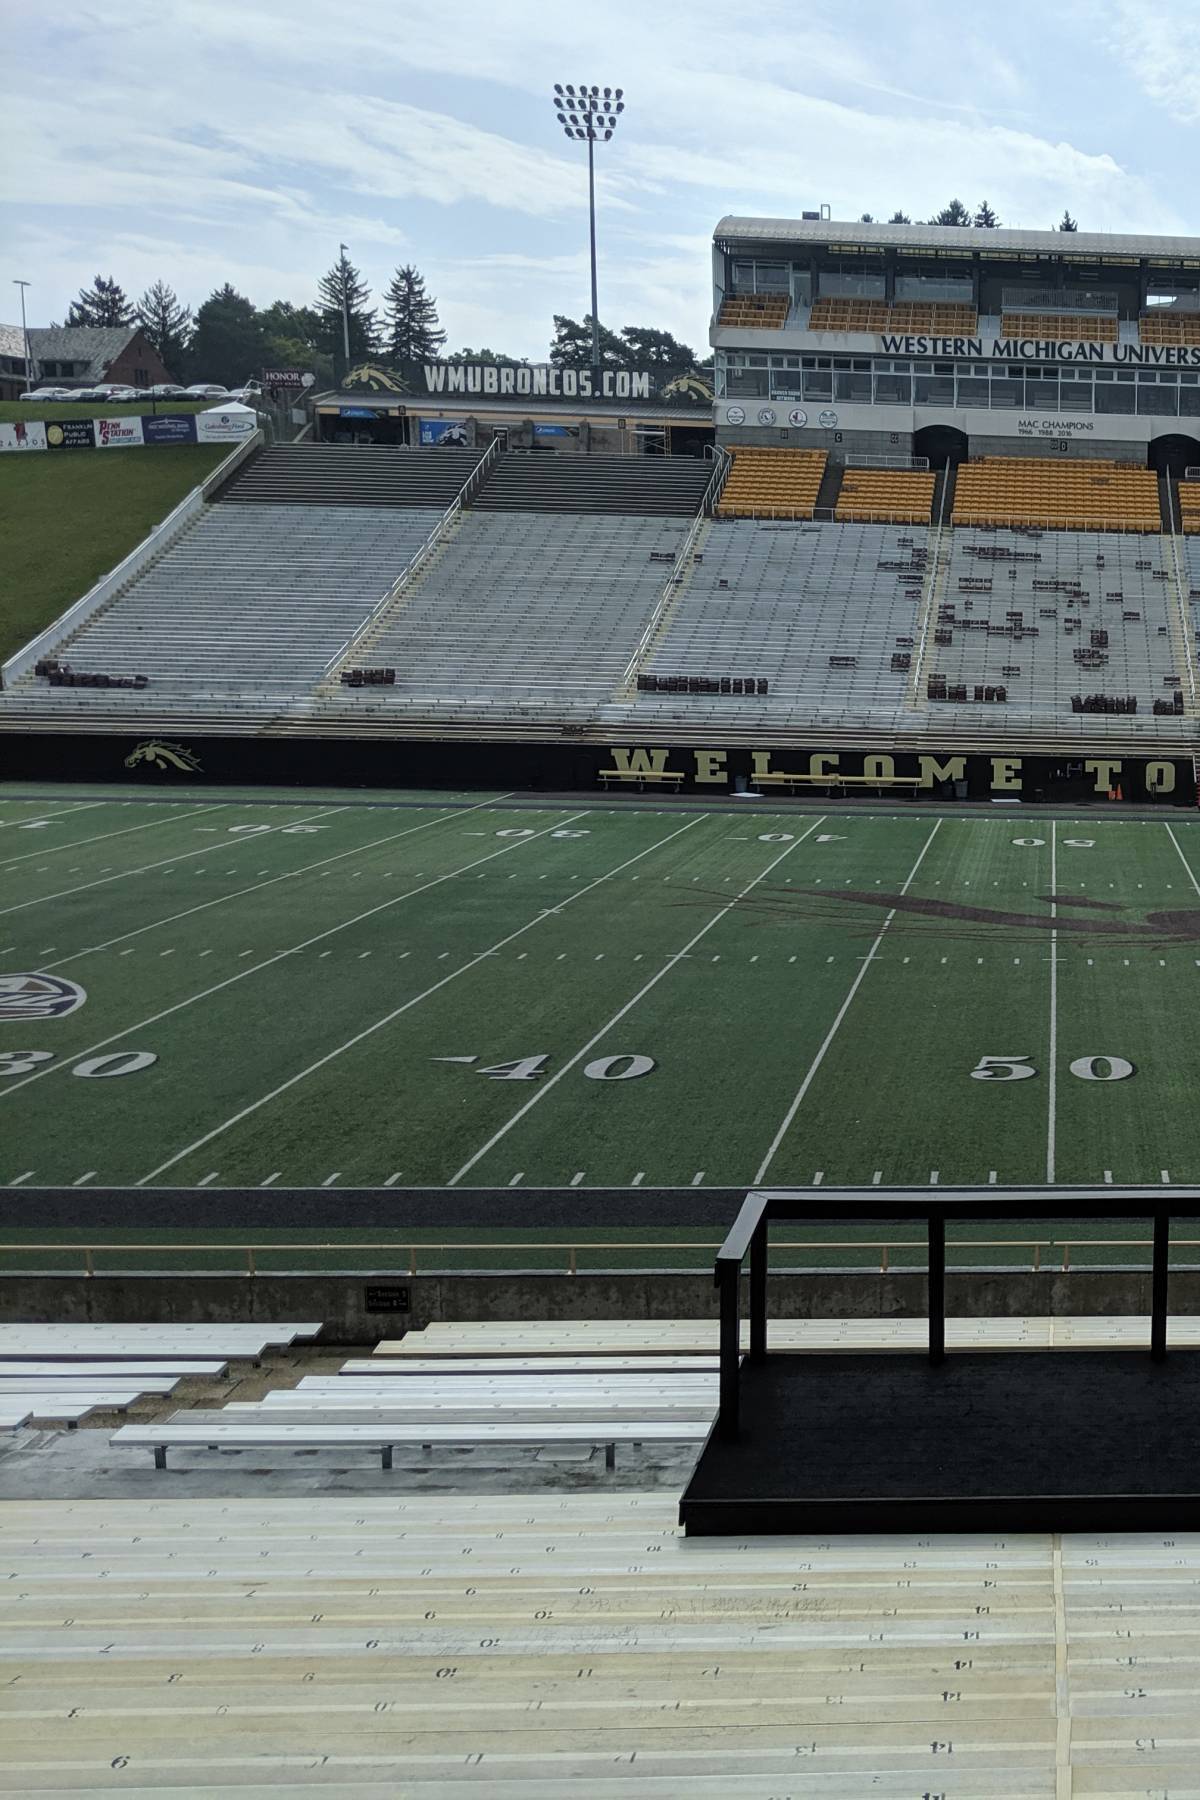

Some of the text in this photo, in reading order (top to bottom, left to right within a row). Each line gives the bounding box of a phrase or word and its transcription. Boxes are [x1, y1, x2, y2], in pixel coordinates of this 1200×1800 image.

[881, 335, 982, 357] WESTERN
[992, 340, 1103, 361] MICHIGAN
[265, 372, 300, 381] HONOR
[424, 365, 649, 398] WMUBRONCOS.COM
[1018, 420, 1094, 431] MAC CHAMPIONS
[1038, 429, 1054, 437] 1988
[611, 748, 1022, 790] WELCOME
[1086, 760, 1176, 793] TO
[1010, 838, 1097, 848] 50
[475, 1053, 656, 1080] 40
[970, 1055, 1134, 1081] 50
